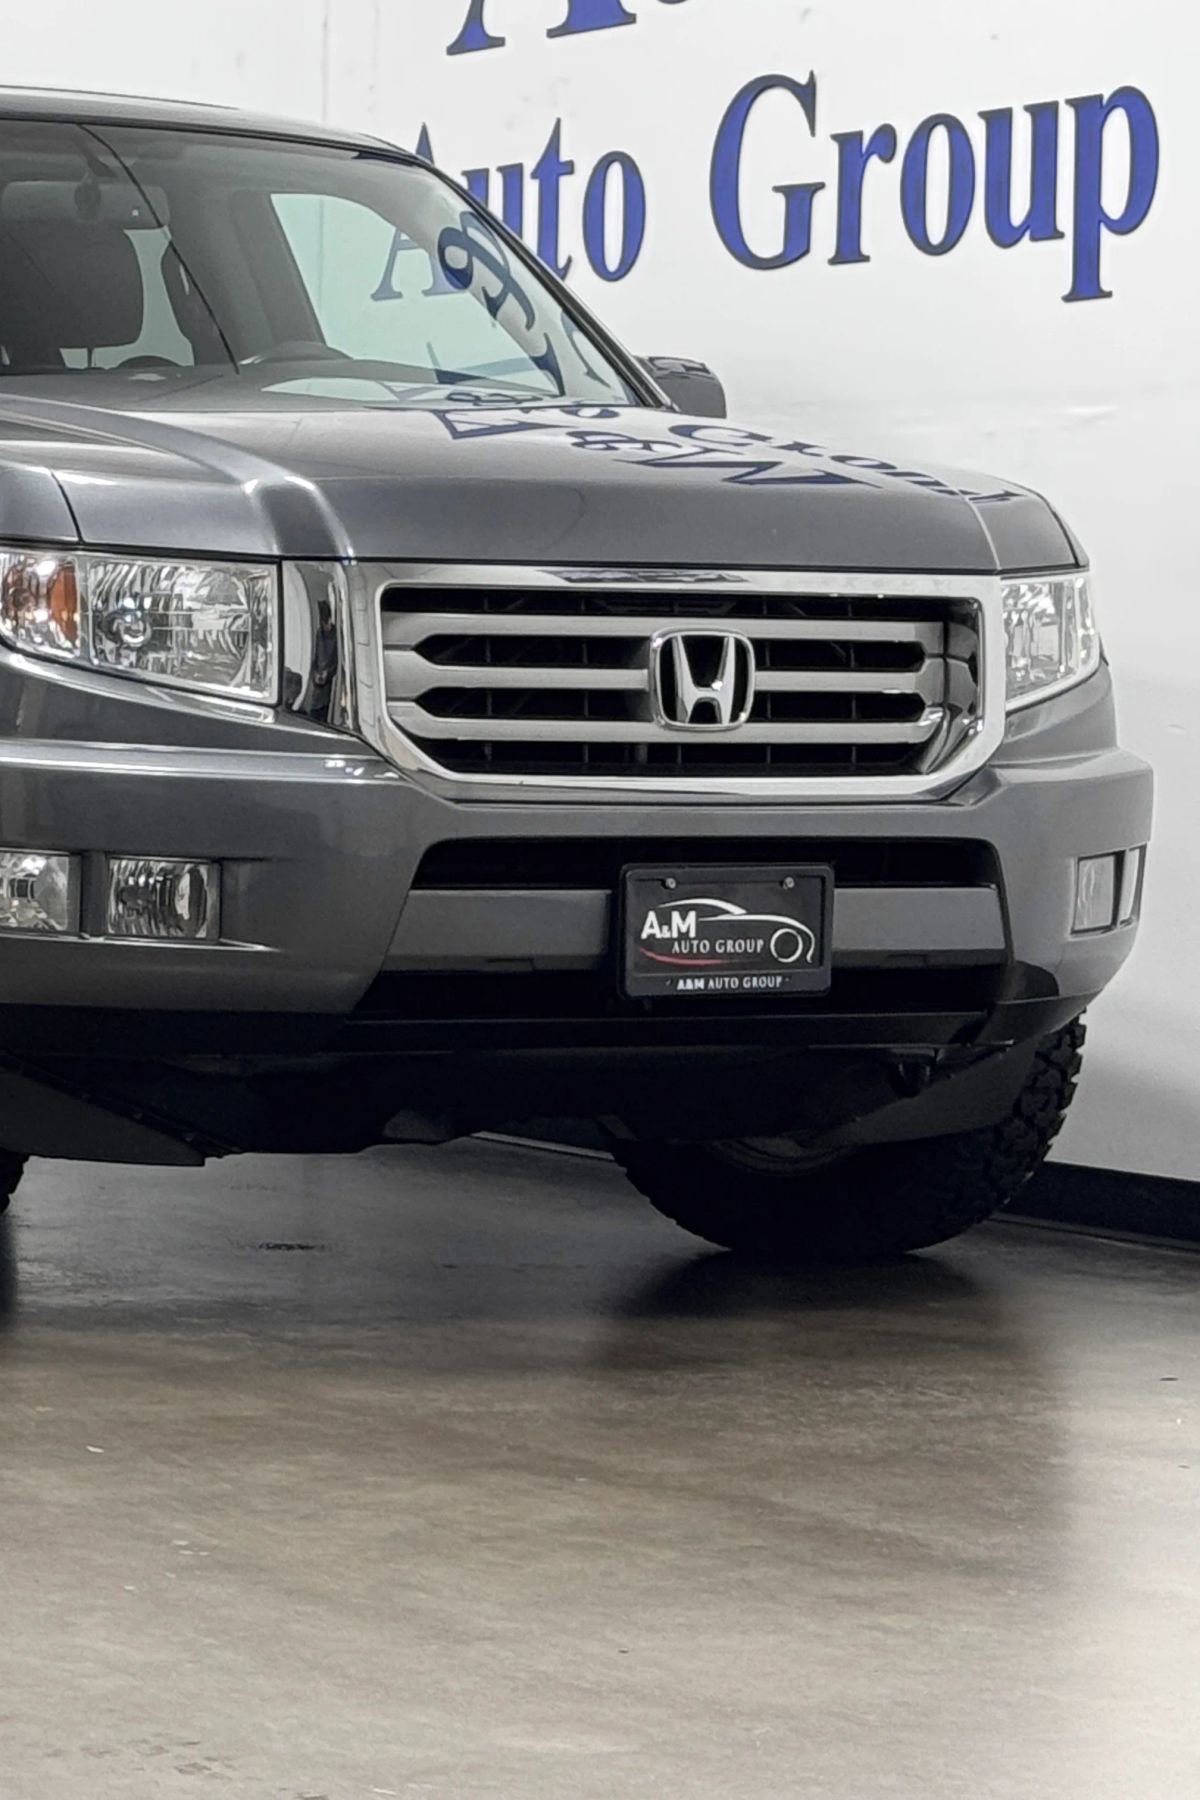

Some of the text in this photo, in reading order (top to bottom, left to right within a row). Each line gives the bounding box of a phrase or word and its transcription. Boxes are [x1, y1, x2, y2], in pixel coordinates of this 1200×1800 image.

[709, 70, 1159, 302] Group
[640, 910, 696, 939] A&M
[671, 939, 764, 954] AUTO GROUP
[708, 977, 739, 990] AUTO
[742, 975, 782, 988] GROUP
